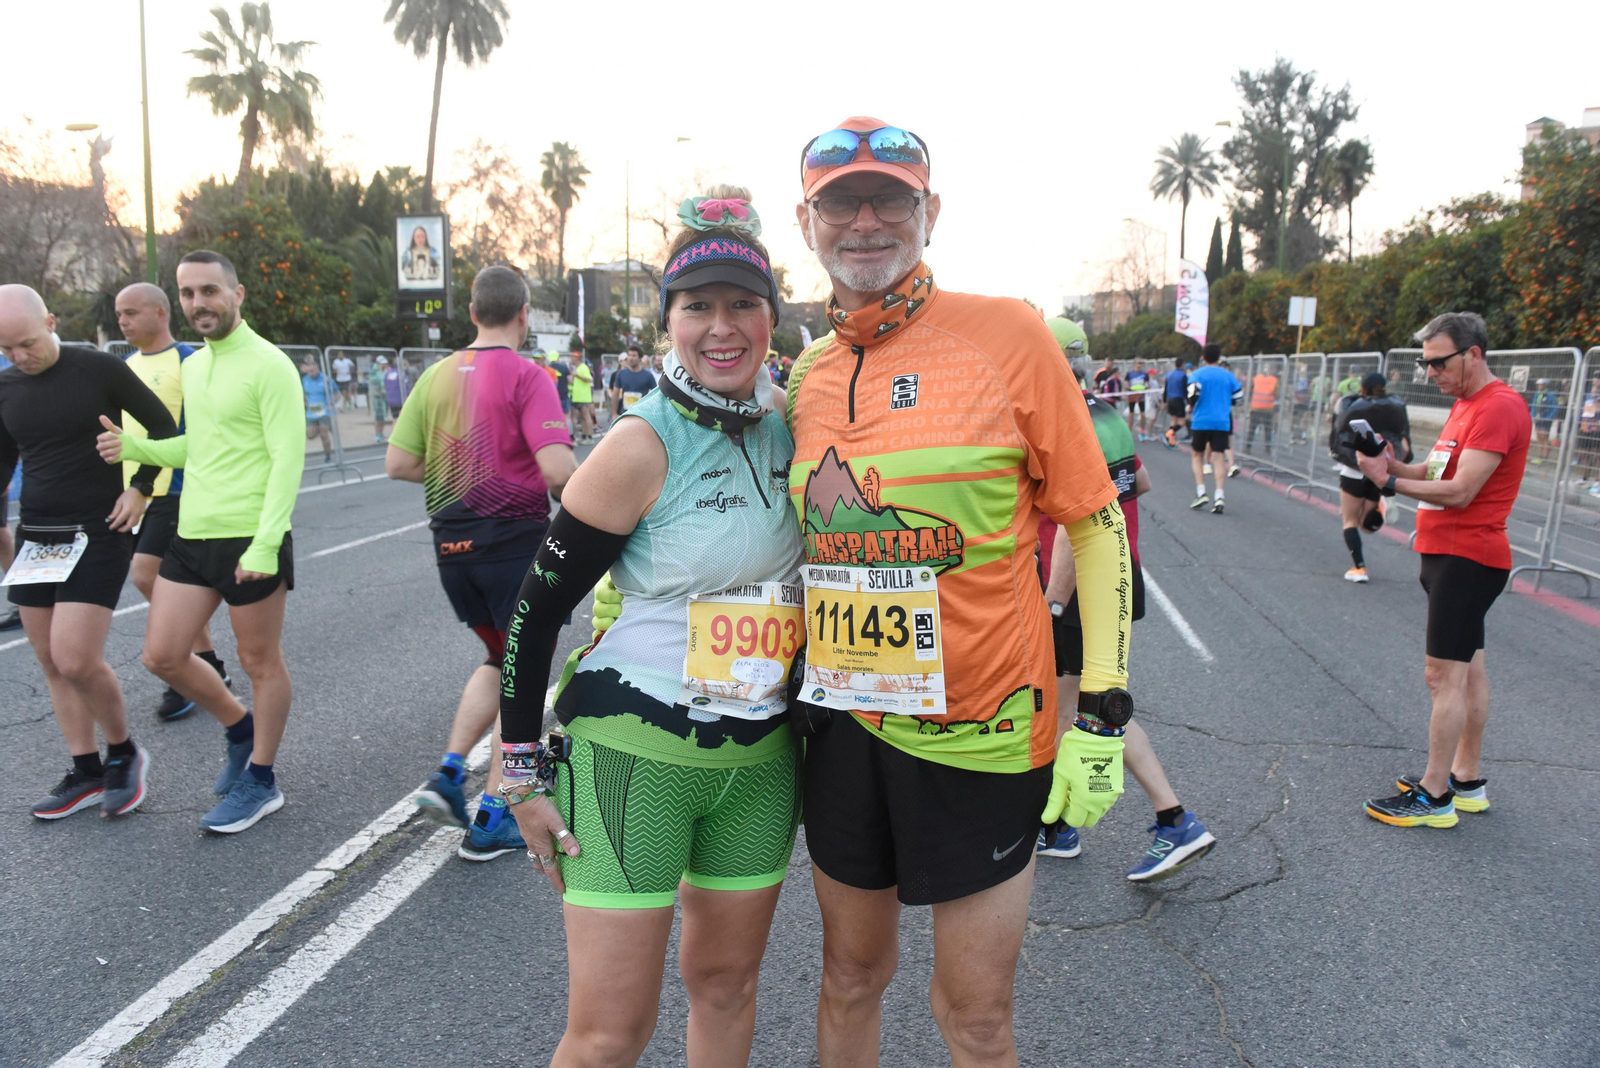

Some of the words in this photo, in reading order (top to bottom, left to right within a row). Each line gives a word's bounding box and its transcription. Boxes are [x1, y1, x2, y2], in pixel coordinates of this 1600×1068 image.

[888, 430, 966, 449] CAMINO
[24, 544, 74, 563] 13849
[439, 540, 473, 557] CMX
[868, 569, 914, 589] SEVILLA
[815, 600, 910, 648] 11143
[710, 614, 798, 659] 9903
